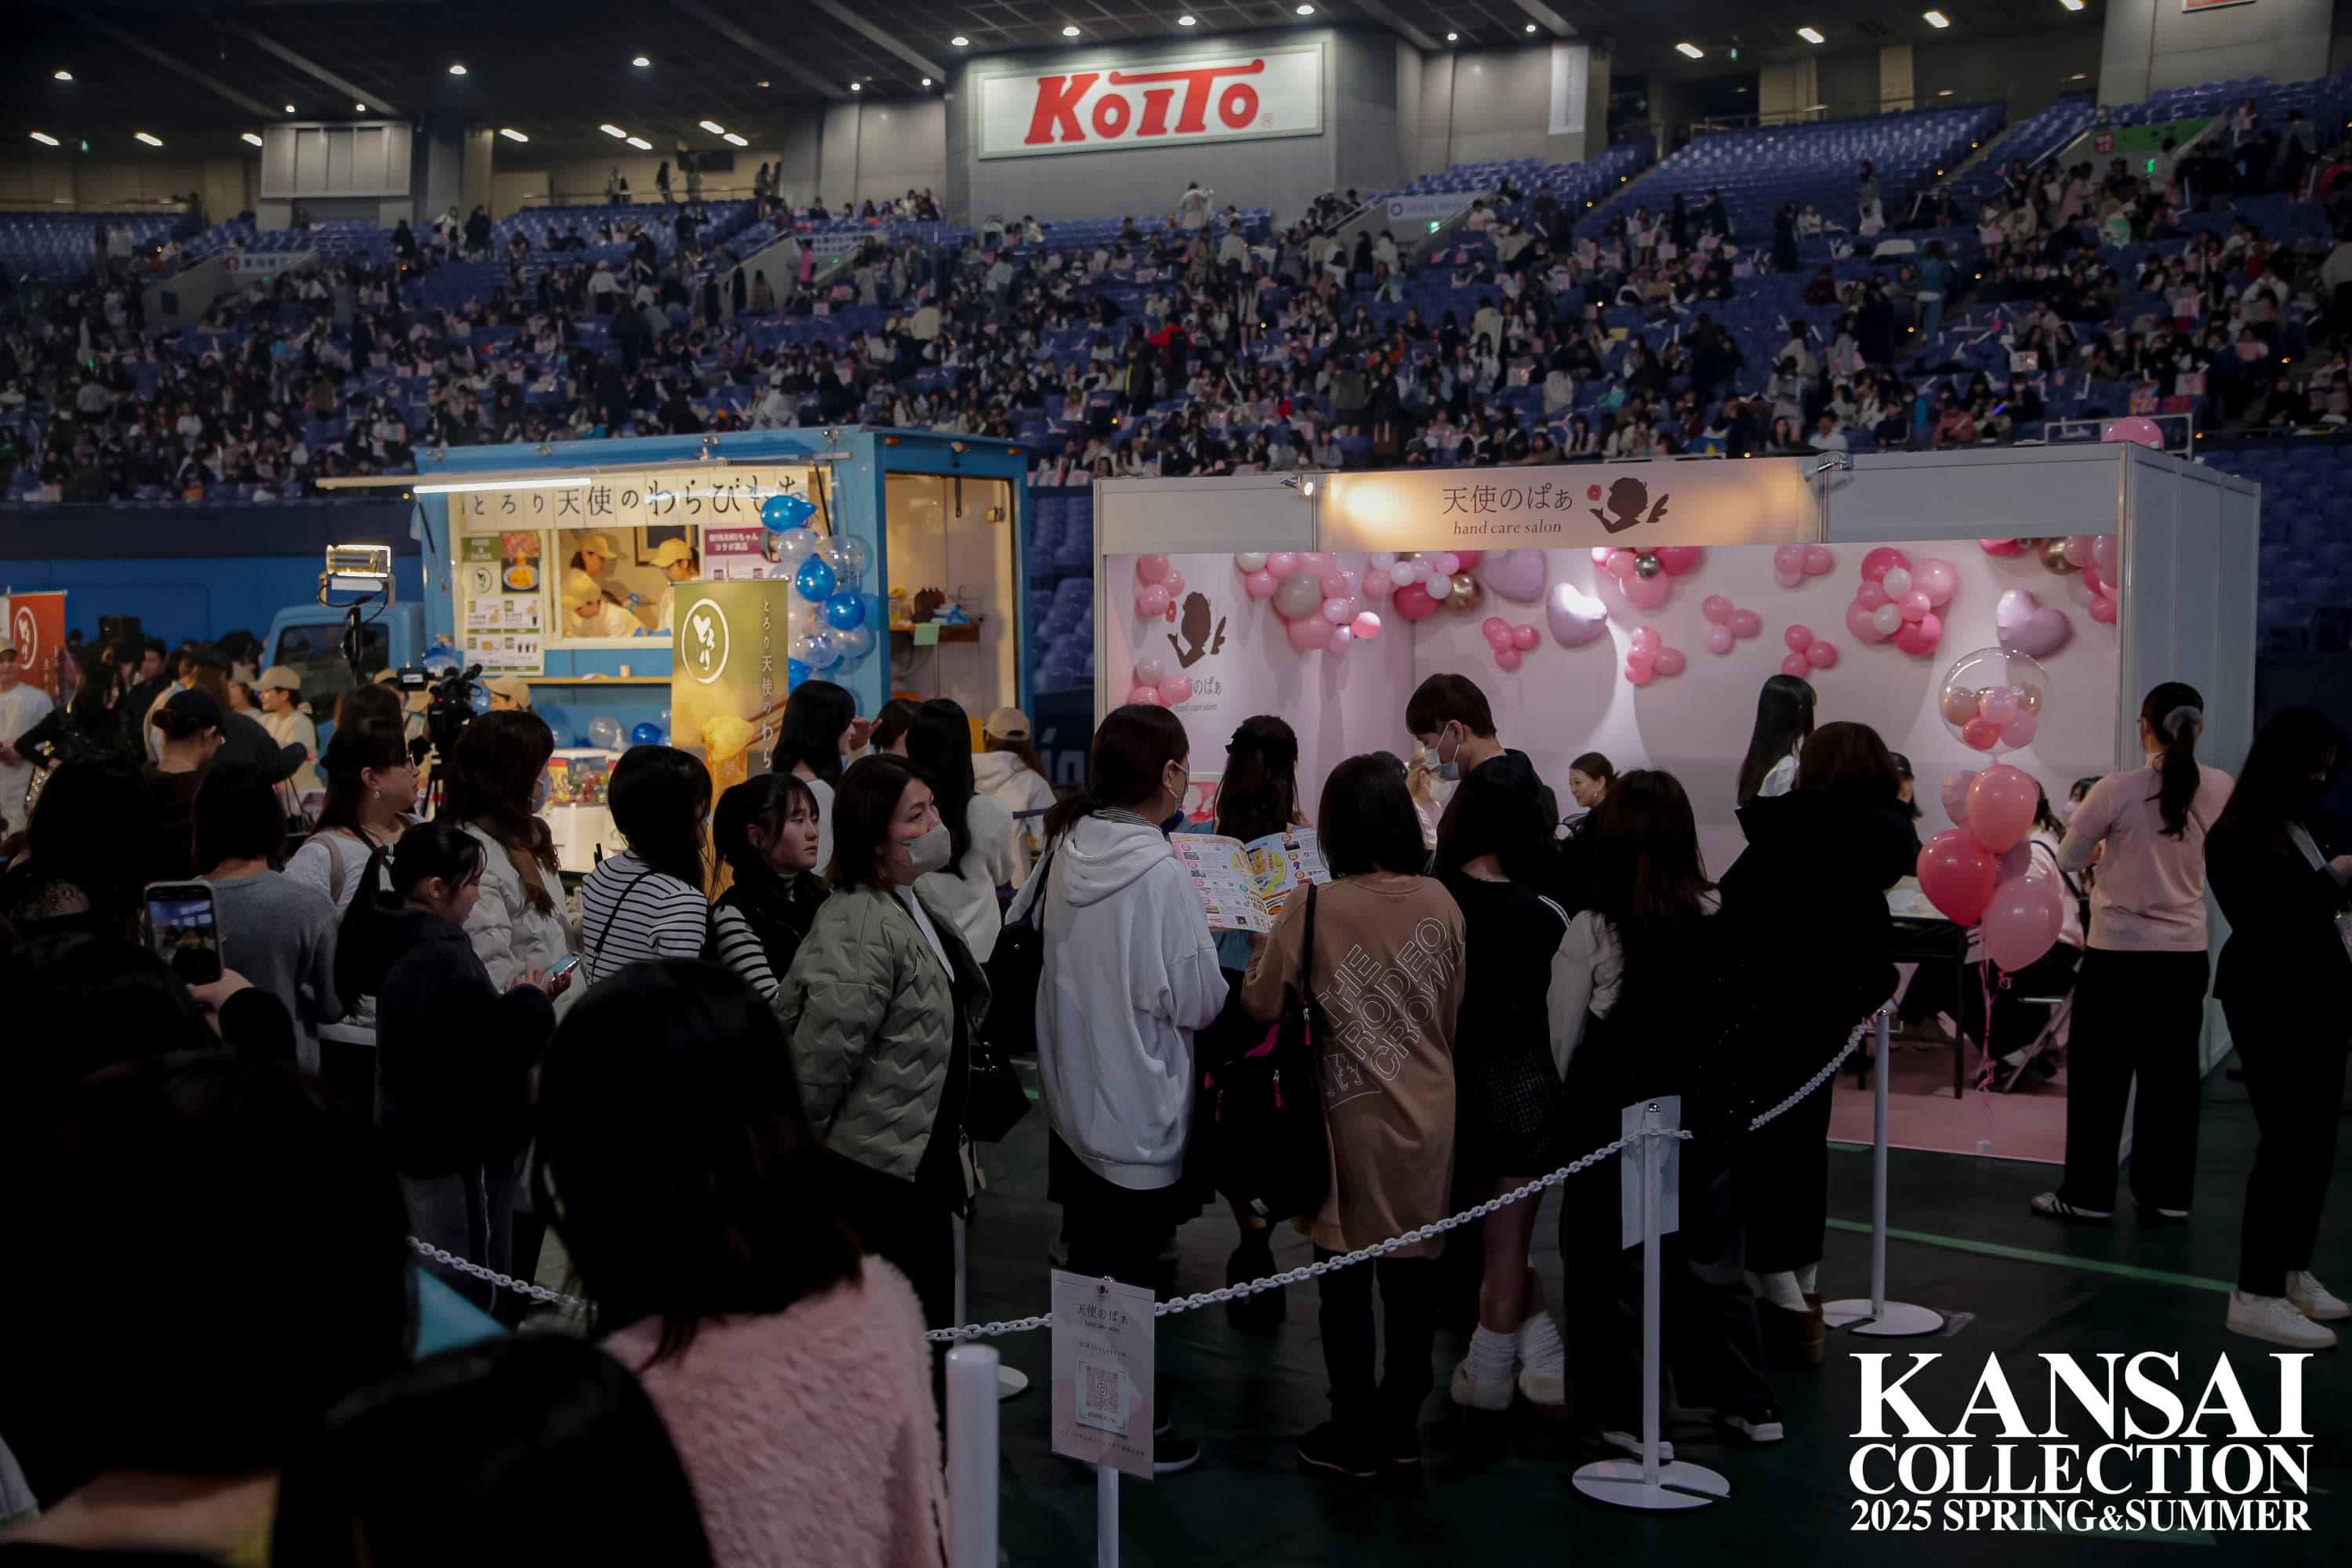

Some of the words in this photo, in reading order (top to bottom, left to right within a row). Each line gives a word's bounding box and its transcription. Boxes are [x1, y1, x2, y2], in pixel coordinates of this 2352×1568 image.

[1443, 482, 1573, 514] 天使のぱぁ
[1453, 521, 1487, 535] hand
[1490, 524, 1521, 534] care
[1524, 519, 1561, 533] salon
[1316, 944, 1382, 1028] THE
[1336, 917, 1447, 1060] RODEO
[1370, 925, 1466, 1081] CROWN
